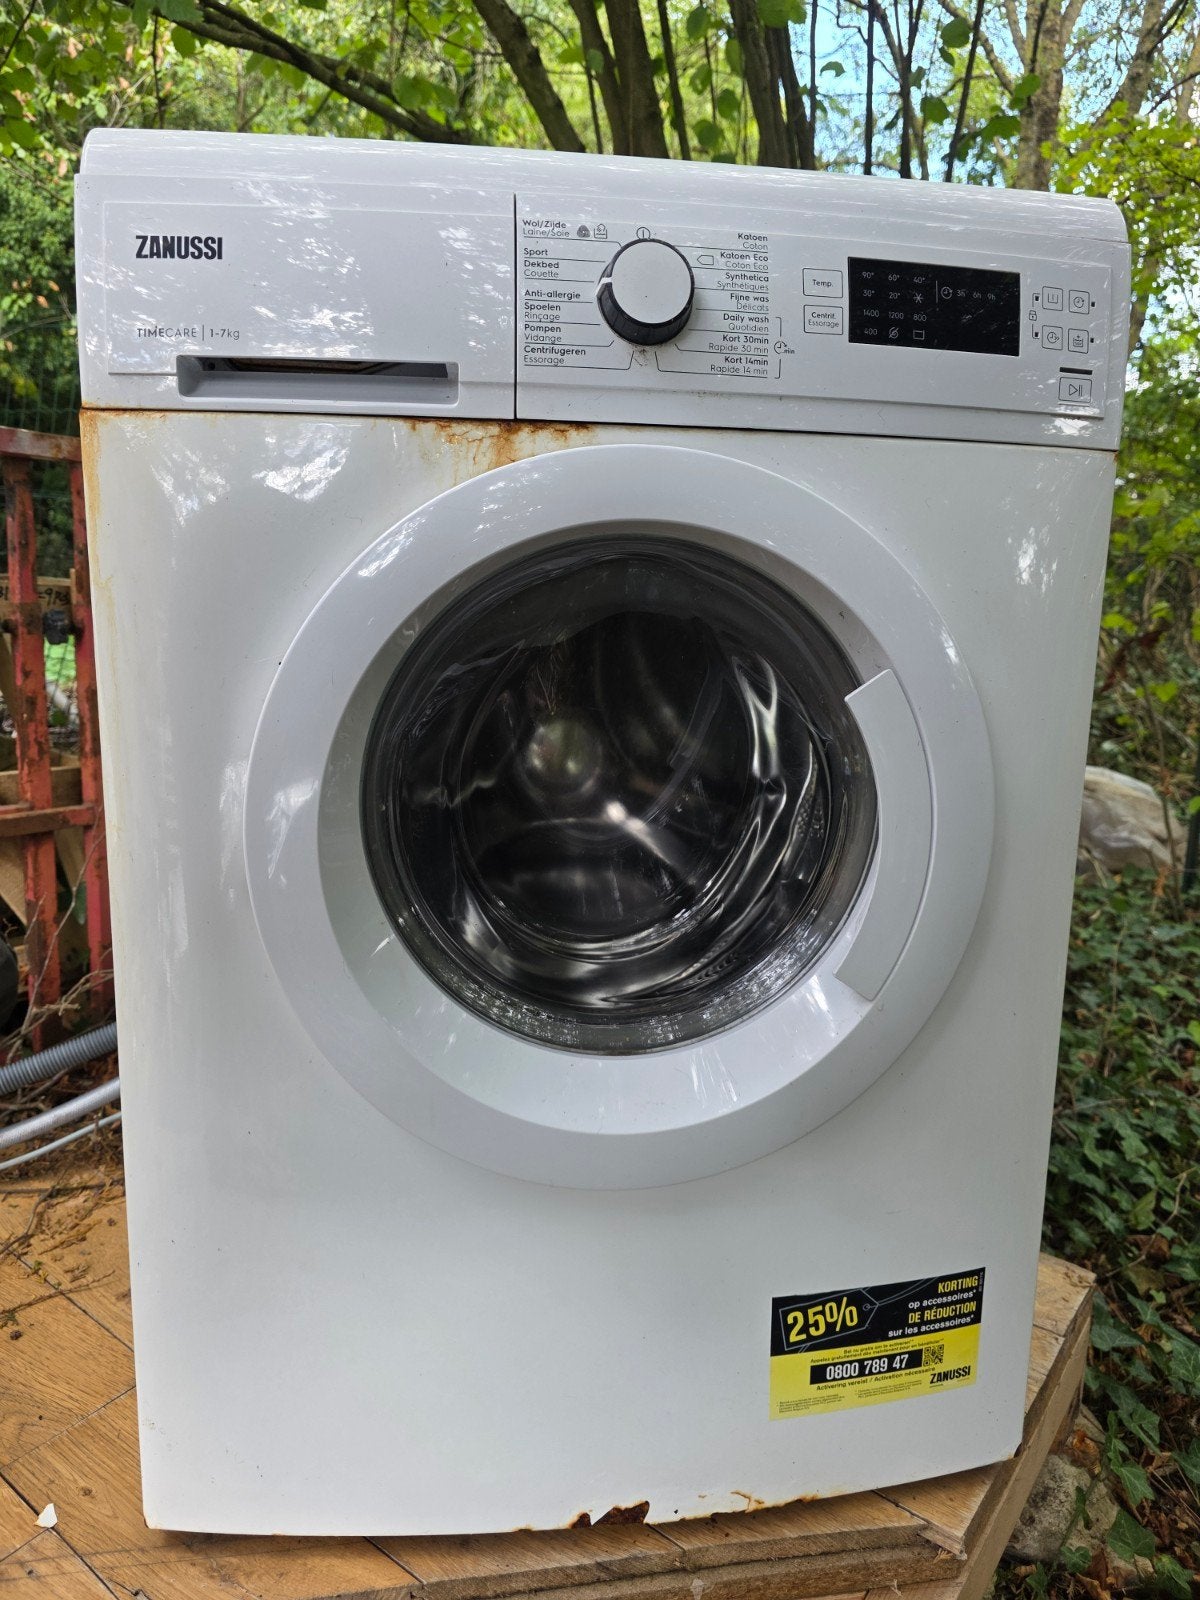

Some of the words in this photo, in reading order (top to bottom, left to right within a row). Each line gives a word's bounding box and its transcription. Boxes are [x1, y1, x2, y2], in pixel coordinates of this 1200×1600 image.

[523, 220, 567, 230] Wol/Zijde
[523, 228, 570, 237] Laine/Soie
[738, 233, 768, 242] Katoen
[136, 235, 223, 260] ZANUSSI
[743, 242, 768, 250] Coton
[523, 248, 548, 256] Sport
[720, 252, 751, 260] Katoen
[753, 254, 768, 262] Eco
[524, 260, 559, 269] Dekbed
[726, 261, 751, 269] Coton
[753, 263, 769, 271] Eco
[524, 269, 559, 278] Couette
[726, 273, 769, 282] Synthetica
[717, 281, 769, 291] Synthétiques
[813, 279, 833, 287] Temp.
[524, 289, 581, 300] Anti-allergie
[730, 293, 752, 302] Fijne
[524, 302, 561, 312] Spoelen
[736, 302, 769, 311] Délicats
[524, 312, 560, 322] Rinçage
[723, 313, 745, 323] Daily
[748, 315, 769, 323] wash
[888, 311, 904, 320] 1200
[728, 323, 769, 332] Quotidien
[808, 319, 840, 328] Essorage
[137, 327, 197, 338] TIMECARE
[210, 328, 240, 340] 1-7kg
[524, 324, 562, 334] Pompen
[524, 334, 562, 344] Vidange
[722, 334, 740, 343] Kort
[743, 335, 769, 344] 30min
[524, 346, 586, 357] Centrifugeren
[708, 343, 739, 352] Rapide
[741, 345, 751, 353] 30
[753, 346, 769, 354] min
[524, 356, 565, 366] Essorage
[724, 356, 742, 364] Kort
[745, 357, 769, 366] 14min
[710, 365, 740, 374] Rapide
[742, 366, 750, 374] 14
[753, 367, 768, 375] min
[938, 1275, 978, 1294] KORTING
[908, 1301, 920, 1309] op
[908, 1311, 921, 1324] DE
[924, 1301, 977, 1321] RÉDUCTION
[787, 1297, 858, 1343] 25%
[888, 1328, 902, 1338] sur
[904, 1326, 918, 1335] les
[826, 1362, 859, 1380] 0800
[864, 1358, 888, 1375] 789
[892, 1354, 909, 1370] 47
[816, 1382, 847, 1391] Activering
[848, 1378, 868, 1386] vereist
[874, 1373, 903, 1382] Activation
[904, 1367, 935, 1377] nécessaire
[930, 1365, 971, 1384] ZANUSSI
